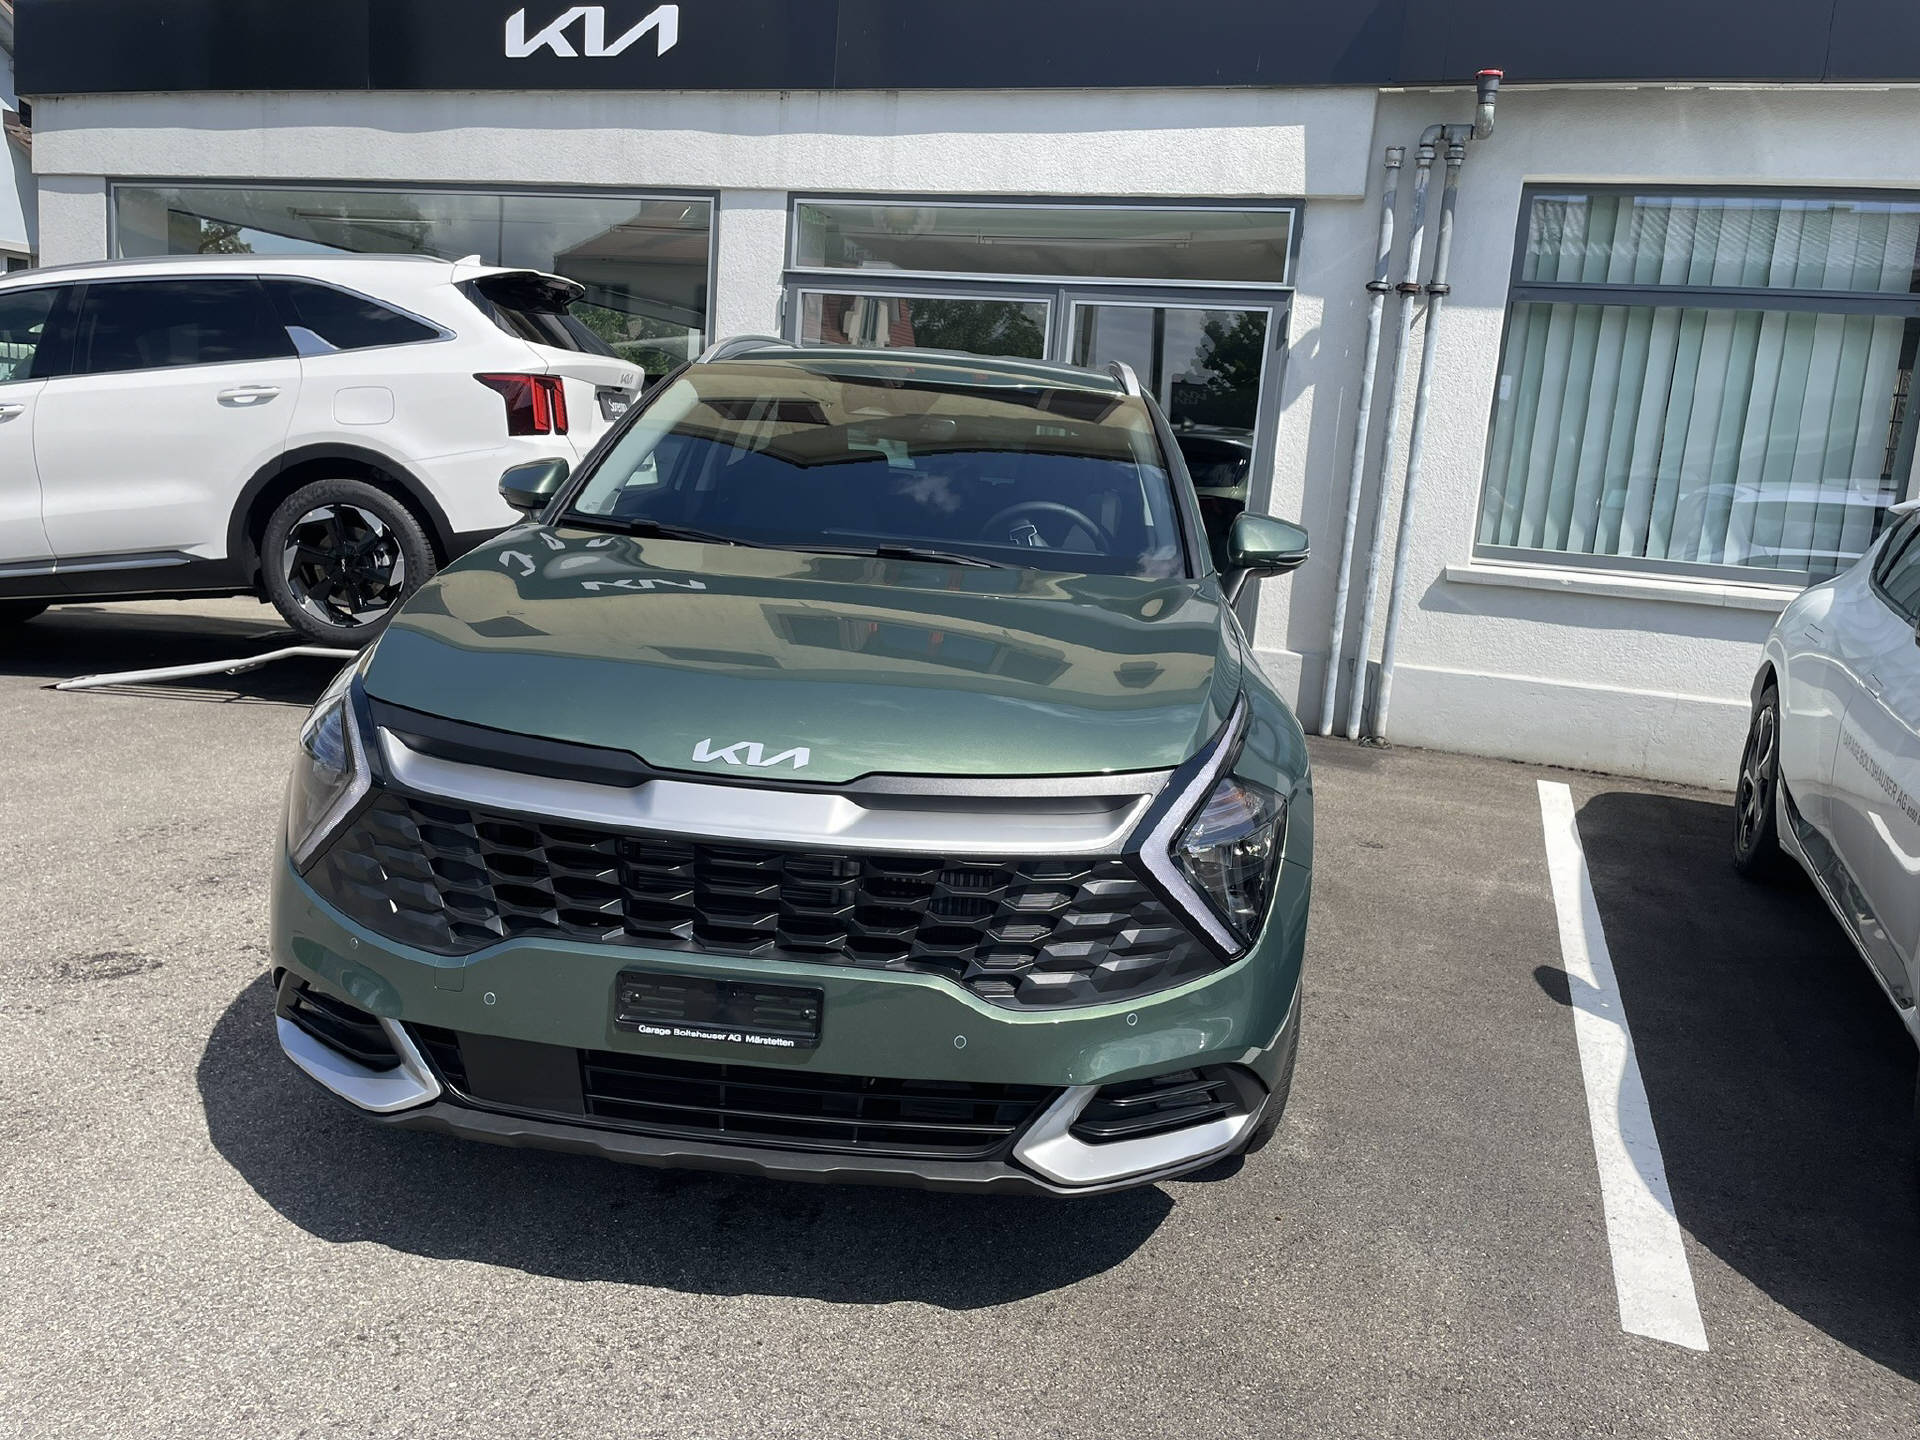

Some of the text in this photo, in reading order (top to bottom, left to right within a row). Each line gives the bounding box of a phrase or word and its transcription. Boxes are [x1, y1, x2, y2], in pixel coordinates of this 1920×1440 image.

[505, 4, 679, 58] KIA
[692, 738, 811, 770] KIA
[1896, 790, 1908, 810] AG
[638, 1024, 794, 1048] Garage Boltshauser AG Märstetten
